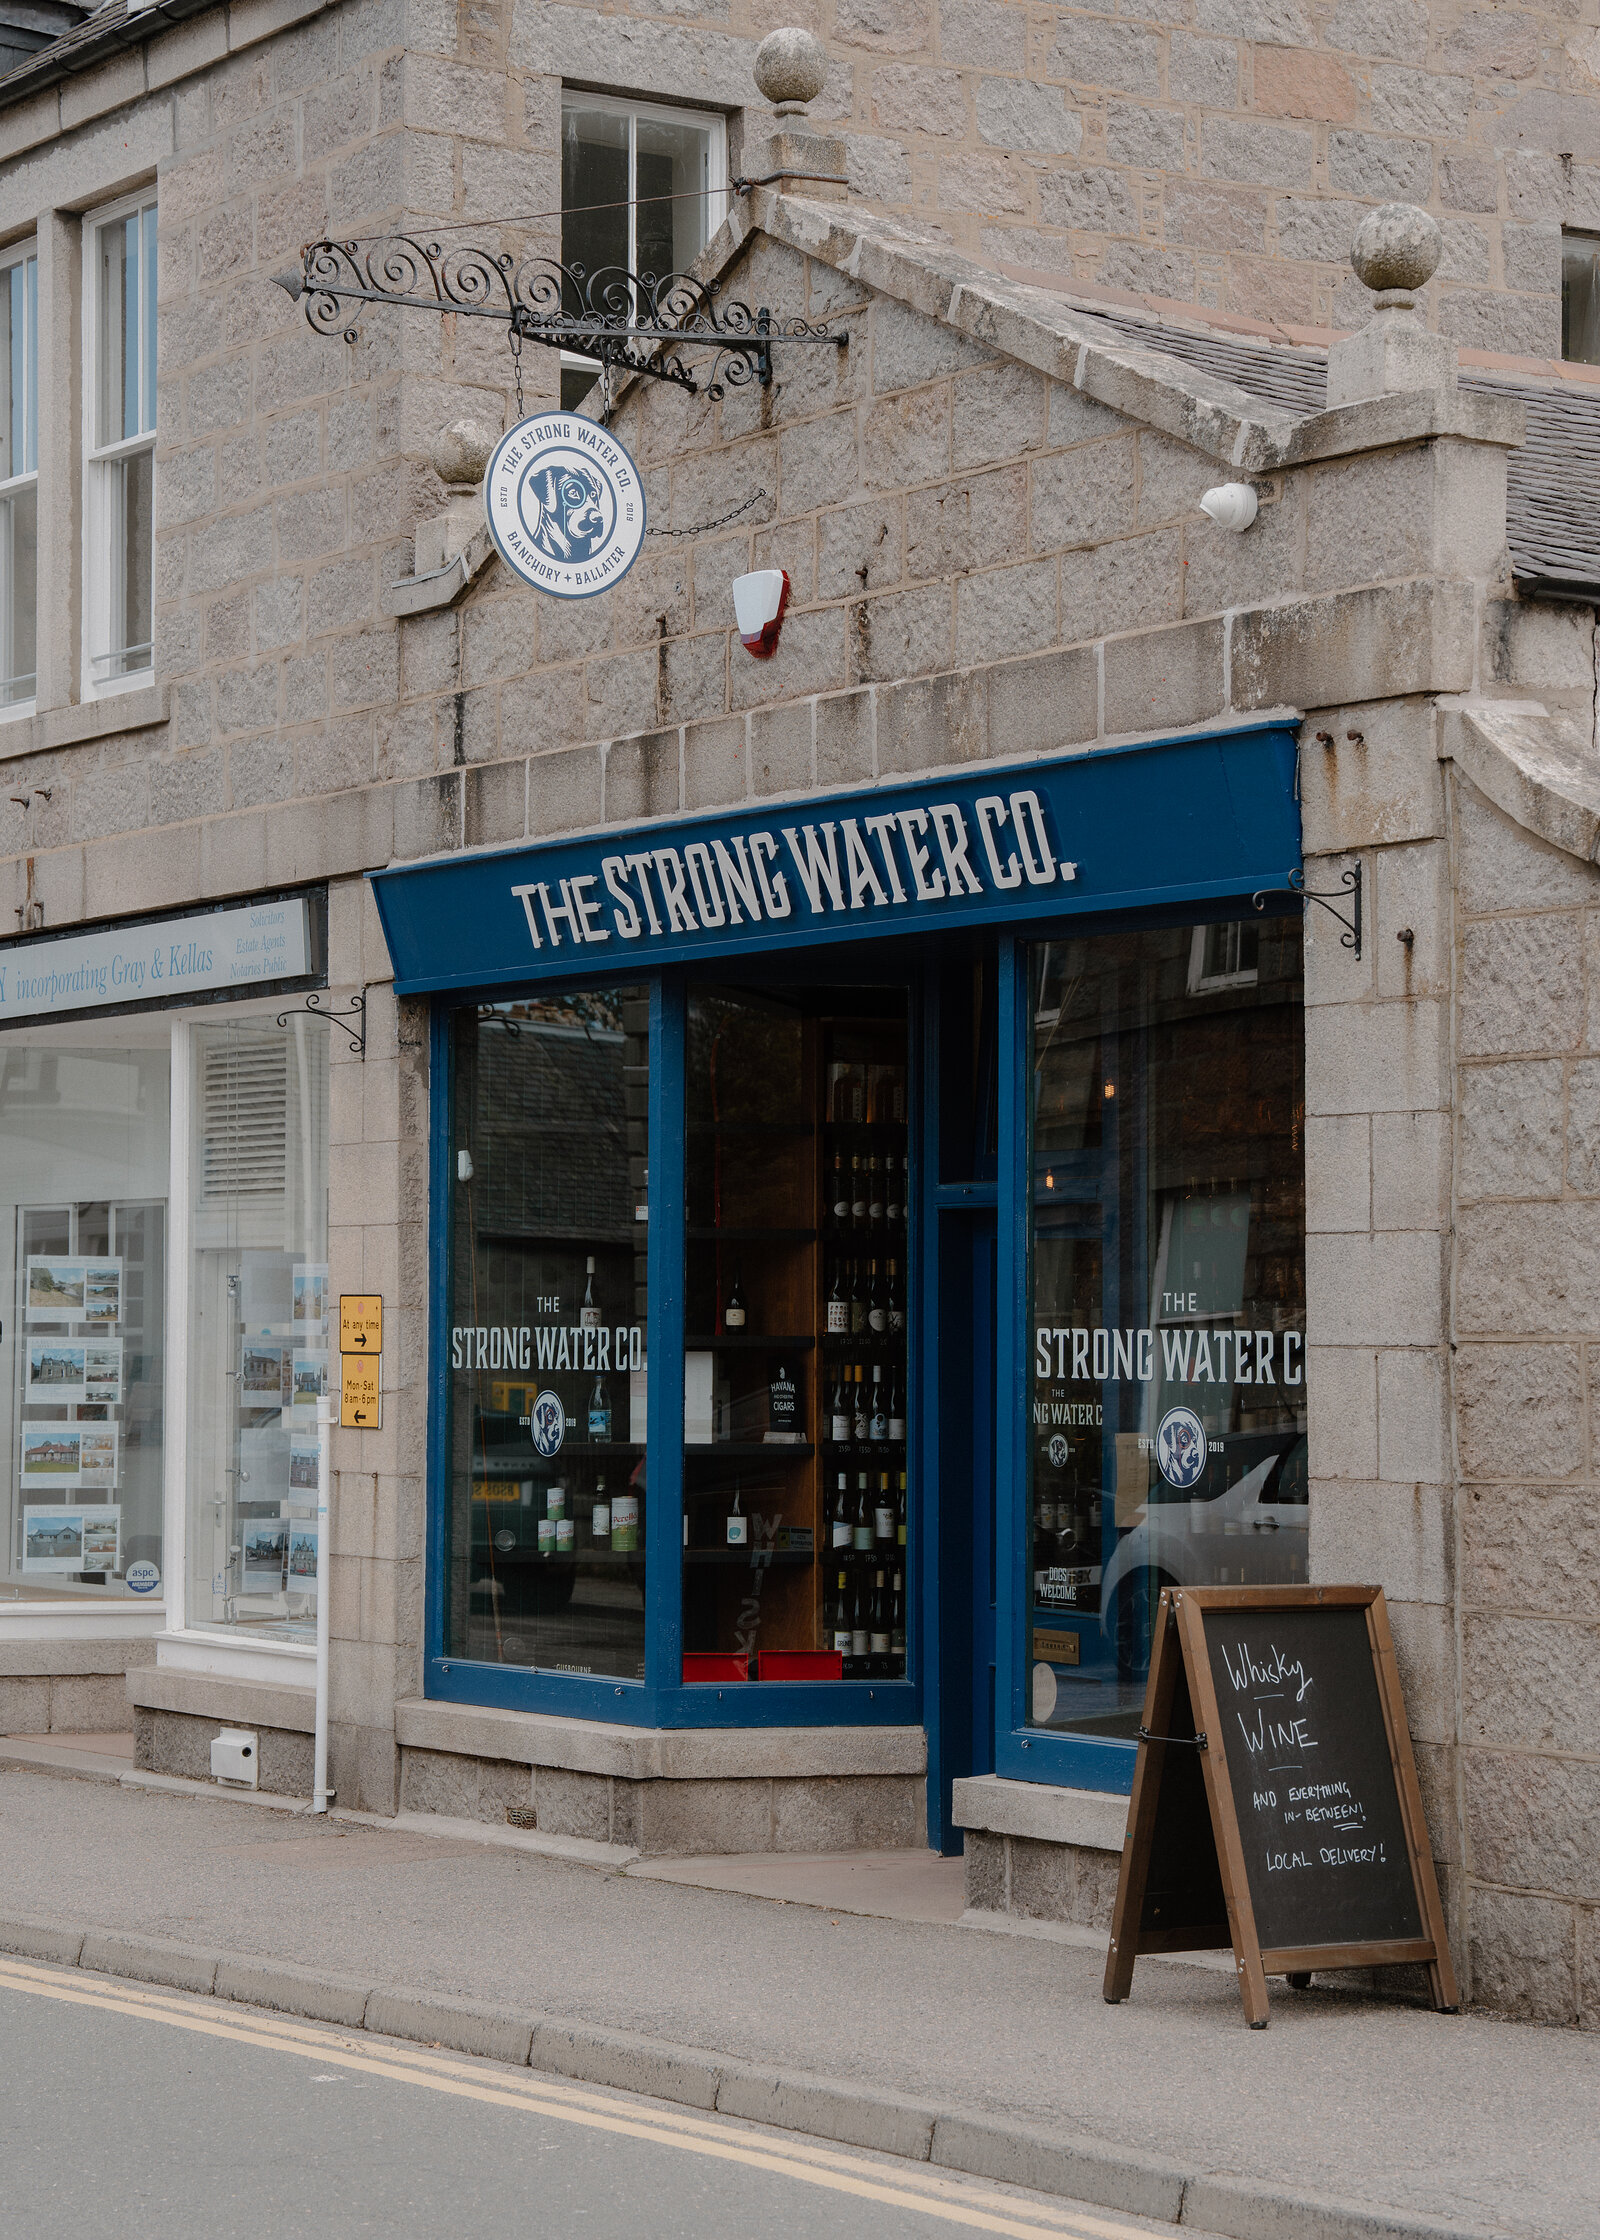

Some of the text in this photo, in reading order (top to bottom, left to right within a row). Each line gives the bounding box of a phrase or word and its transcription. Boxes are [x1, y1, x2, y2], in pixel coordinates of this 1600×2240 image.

[501, 423, 631, 493] THE STRONG WATER CO.
[500, 486, 508, 508] ESTD
[625, 502, 634, 522] 2019
[507, 530, 626, 585] BANCHORY BALLATER
[511, 790, 1077, 949] THE STRONG WATER CO.
[249, 909, 285, 929] Solicitors
[236, 933, 286, 955] Estate Agents
[16, 959, 107, 1002] incorporating
[111, 954, 146, 990] Gray
[151, 948, 164, 980] &
[168, 942, 213, 977] Kellas
[263, 956, 288, 974] Public
[536, 1296, 560, 1313] THE
[1163, 1292, 1197, 1312] THE
[343, 1319, 379, 1331] At any time
[452, 1327, 531, 1370] STRONG
[535, 1327, 611, 1371] WATER
[1036, 1327, 1308, 1386] STRONG WATER C
[770, 1381, 796, 1394] HAVANA
[1051, 1388, 1065, 1398] THE
[773, 1401, 795, 1412] CIGARS
[1050, 1403, 1093, 1426] WATER
[1208, 1441, 1225, 1453] 2019
[132, 1569, 154, 1580] aspc
[1049, 1566, 1067, 1582] DOGS
[1040, 1583, 1077, 1600] WELCOME
[1221, 1642, 1313, 1702] Whisky
[1237, 1708, 1319, 1752] WINE
[1253, 1781, 1352, 1811] AND EVERYTHING
[1266, 1843, 1386, 1871] LOCAL DELIVERY!
